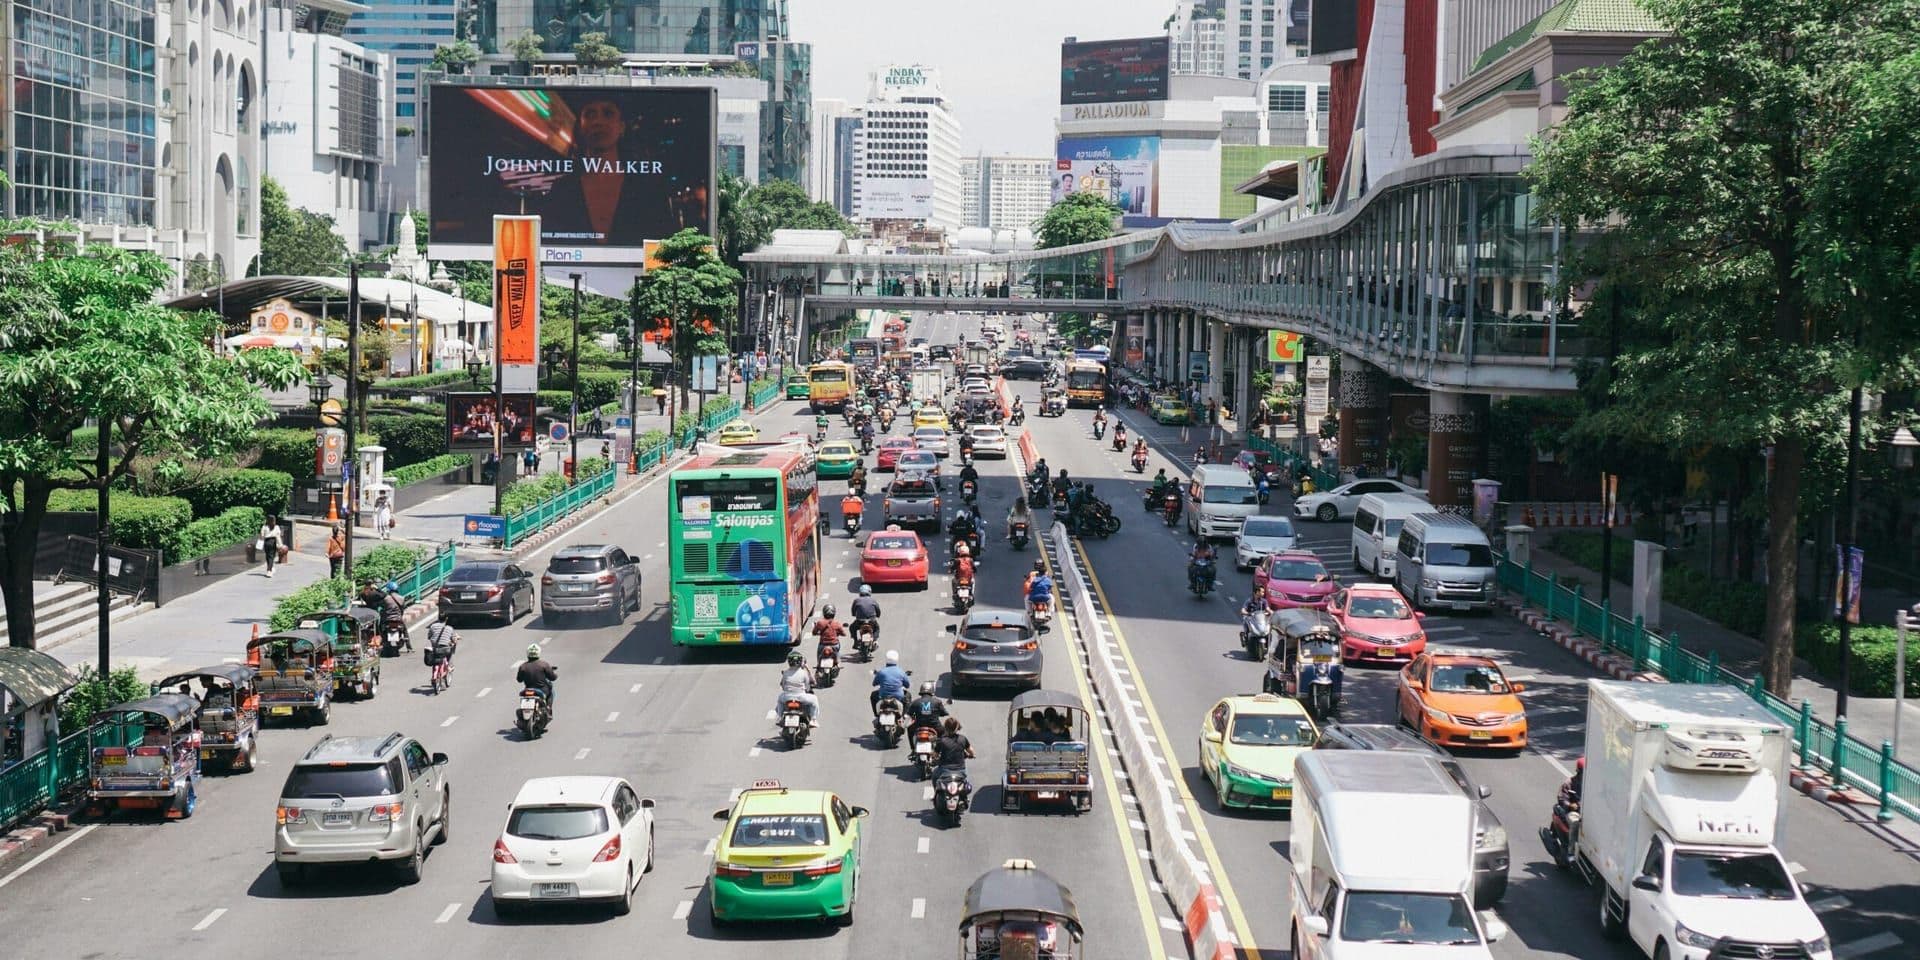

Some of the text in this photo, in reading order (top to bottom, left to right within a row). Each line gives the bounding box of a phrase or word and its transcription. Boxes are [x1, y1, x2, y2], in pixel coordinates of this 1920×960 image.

[885, 76, 928, 85] REGENT
[1074, 103, 1151, 119] PALLADIUM
[484, 156, 663, 176] JOHNNIE WALKER
[511, 302, 523, 328] KEEP
[715, 513, 774, 528] Salonpas
[1710, 751, 1740, 759] MPC
[741, 816, 823, 826] SMART TAXI
